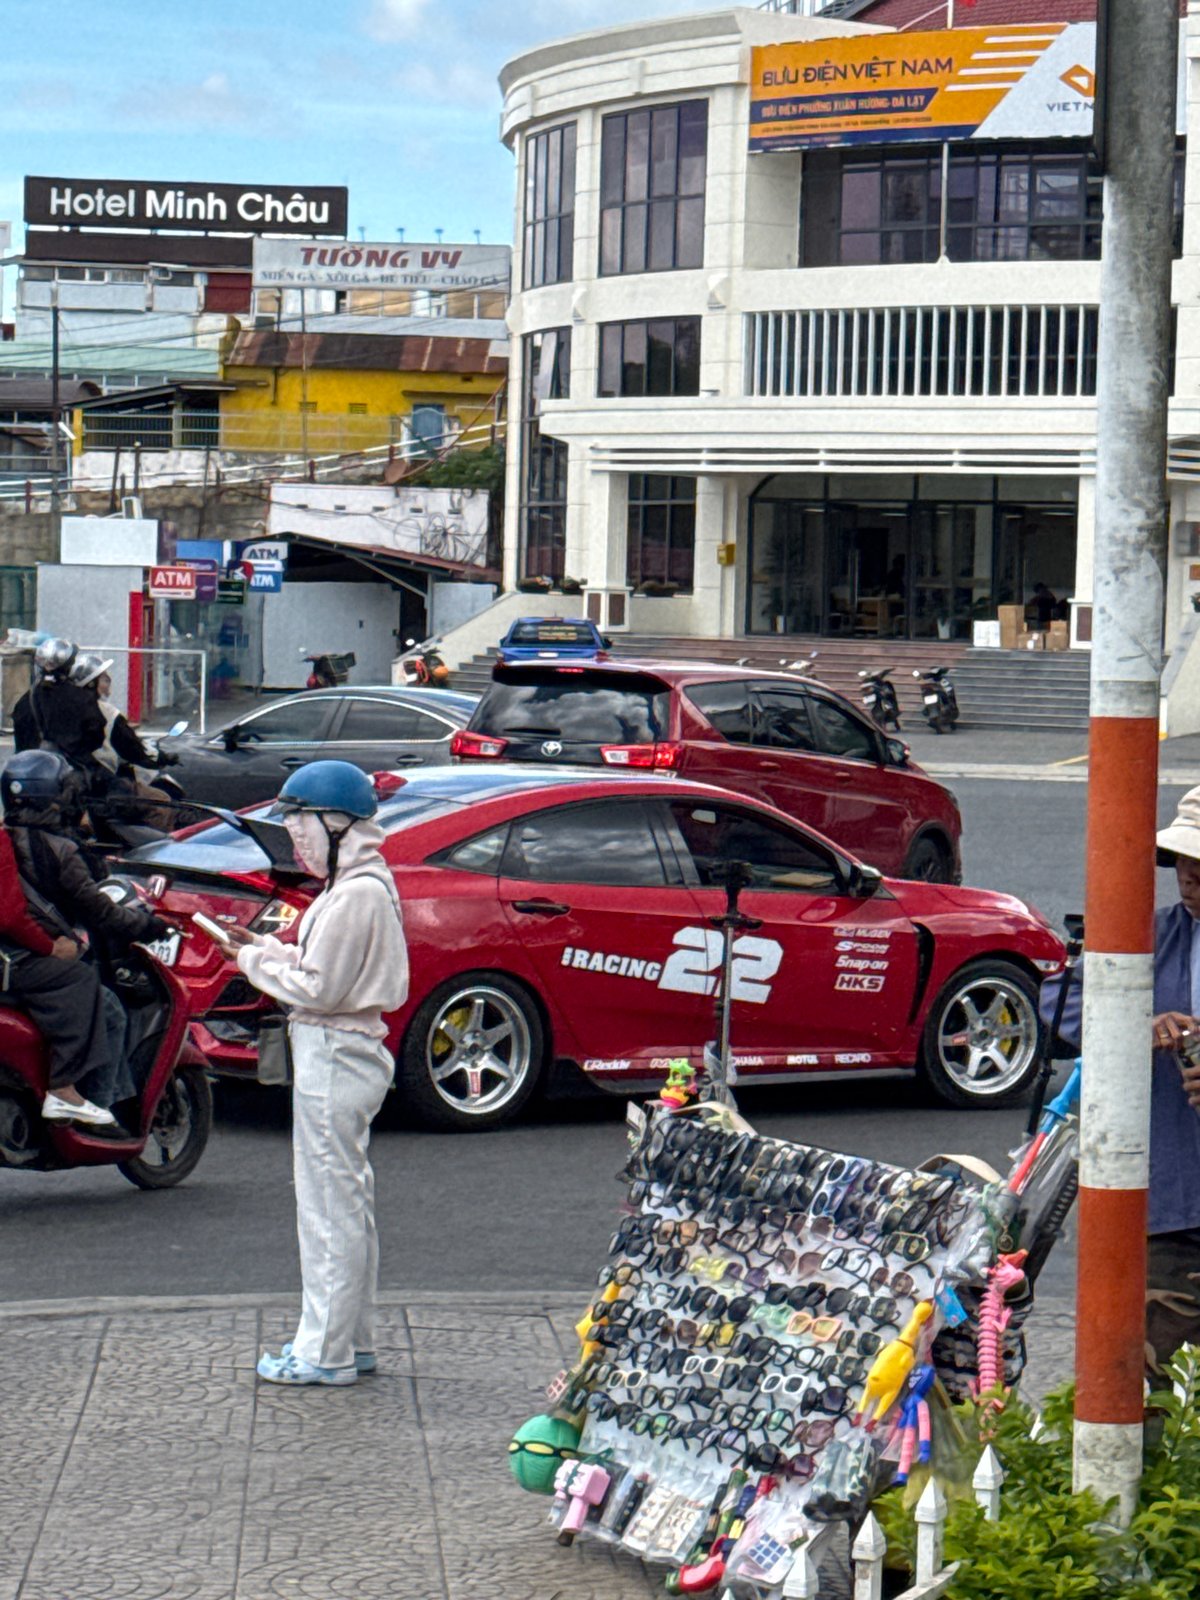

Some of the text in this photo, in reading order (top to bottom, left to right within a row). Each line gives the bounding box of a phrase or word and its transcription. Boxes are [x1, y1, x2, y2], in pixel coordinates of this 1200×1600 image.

[802, 58, 847, 86] ĐIỆN
[850, 56, 898, 83] VIỆT
[901, 57, 953, 76] NAM
[50, 187, 329, 224] Hotel Minh Châu
[300, 245, 463, 269] TƯỜNG VY
[247, 548, 279, 560] ATM
[154, 571, 192, 587] ATM
[658, 926, 784, 1004] 22
[838, 975, 882, 990] HKS
[787, 1055, 818, 1065] MOTUL
